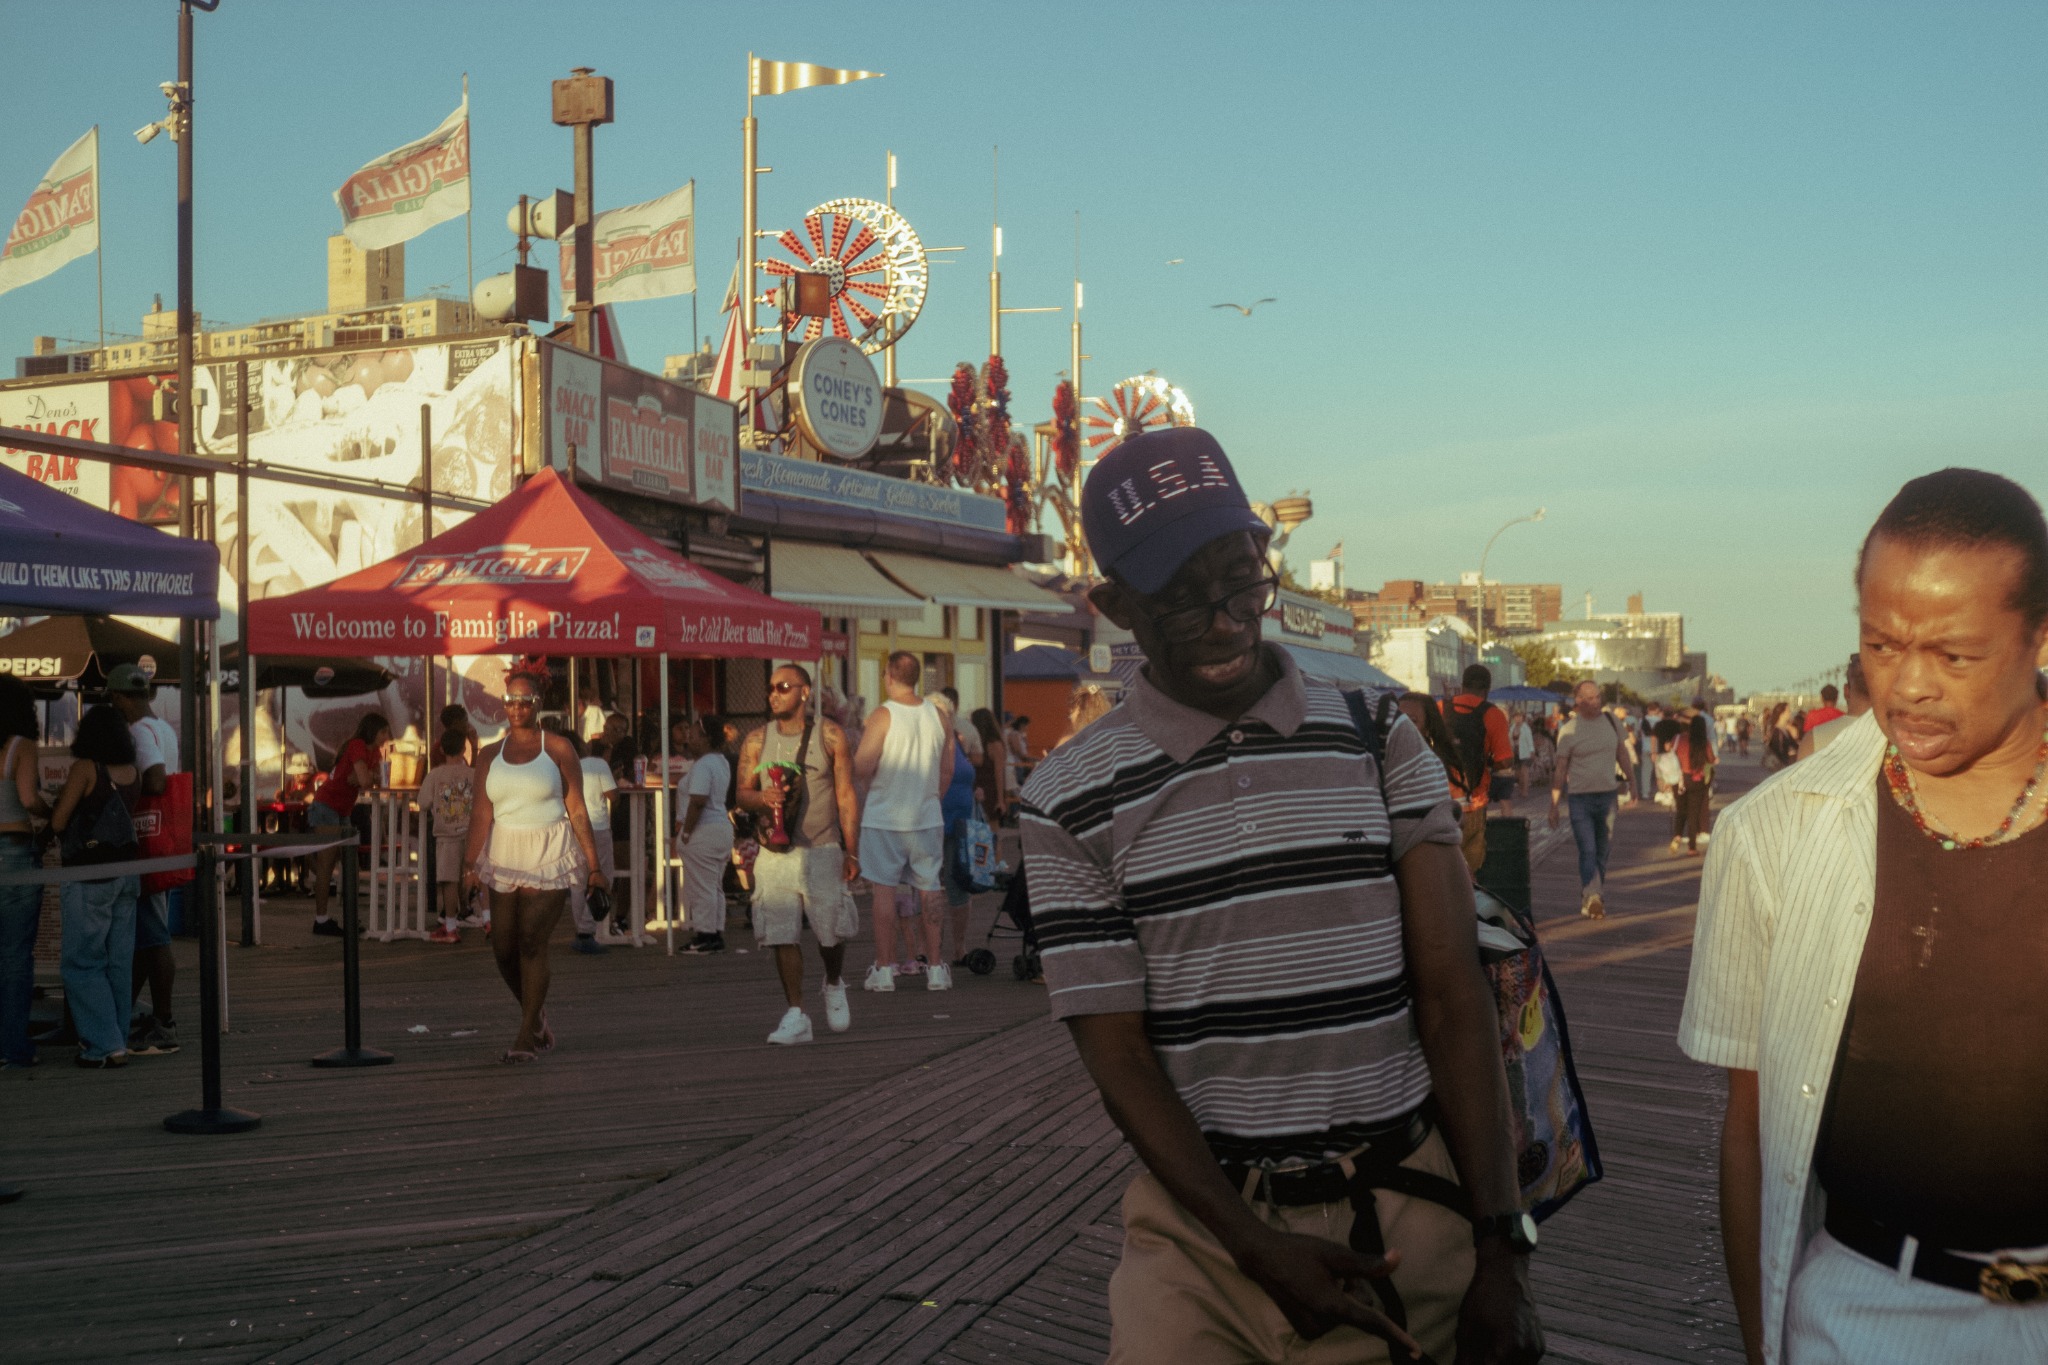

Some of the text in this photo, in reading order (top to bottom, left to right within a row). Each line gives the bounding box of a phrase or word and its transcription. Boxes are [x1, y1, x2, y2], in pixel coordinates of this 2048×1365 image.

[556, 385, 596, 422] SNACK
[814, 373, 872, 406] CONEY'S
[26, 394, 78, 420] Deno's
[821, 399, 866, 428] CONES
[564, 416, 588, 448] BAR
[611, 417, 685, 474] FAMIGLIA
[698, 427, 729, 458] SNACK
[27, 454, 79, 483] BAR
[705, 455, 723, 480] BAR
[764, 460, 832, 487] Homemade
[32, 563, 71, 587] THEM
[71, 566, 101, 590] LIKE
[101, 569, 131, 592] THIS
[132, 570, 193, 596] ANYMORE!
[407, 557, 568, 581] FAMIGLIA
[291, 612, 396, 640] Welcome
[404, 614, 426, 638] to
[434, 611, 540, 644] Famiglia
[547, 612, 620, 639] Pizza!
[681, 616, 698, 642] Ice
[699, 616, 721, 644] Cold
[722, 616, 745, 643] Beer
[747, 619, 765, 643] and
[766, 620, 783, 647] Hot
[783, 622, 809, 649] Pizza!
[0, 657, 61, 676] PEPSI
